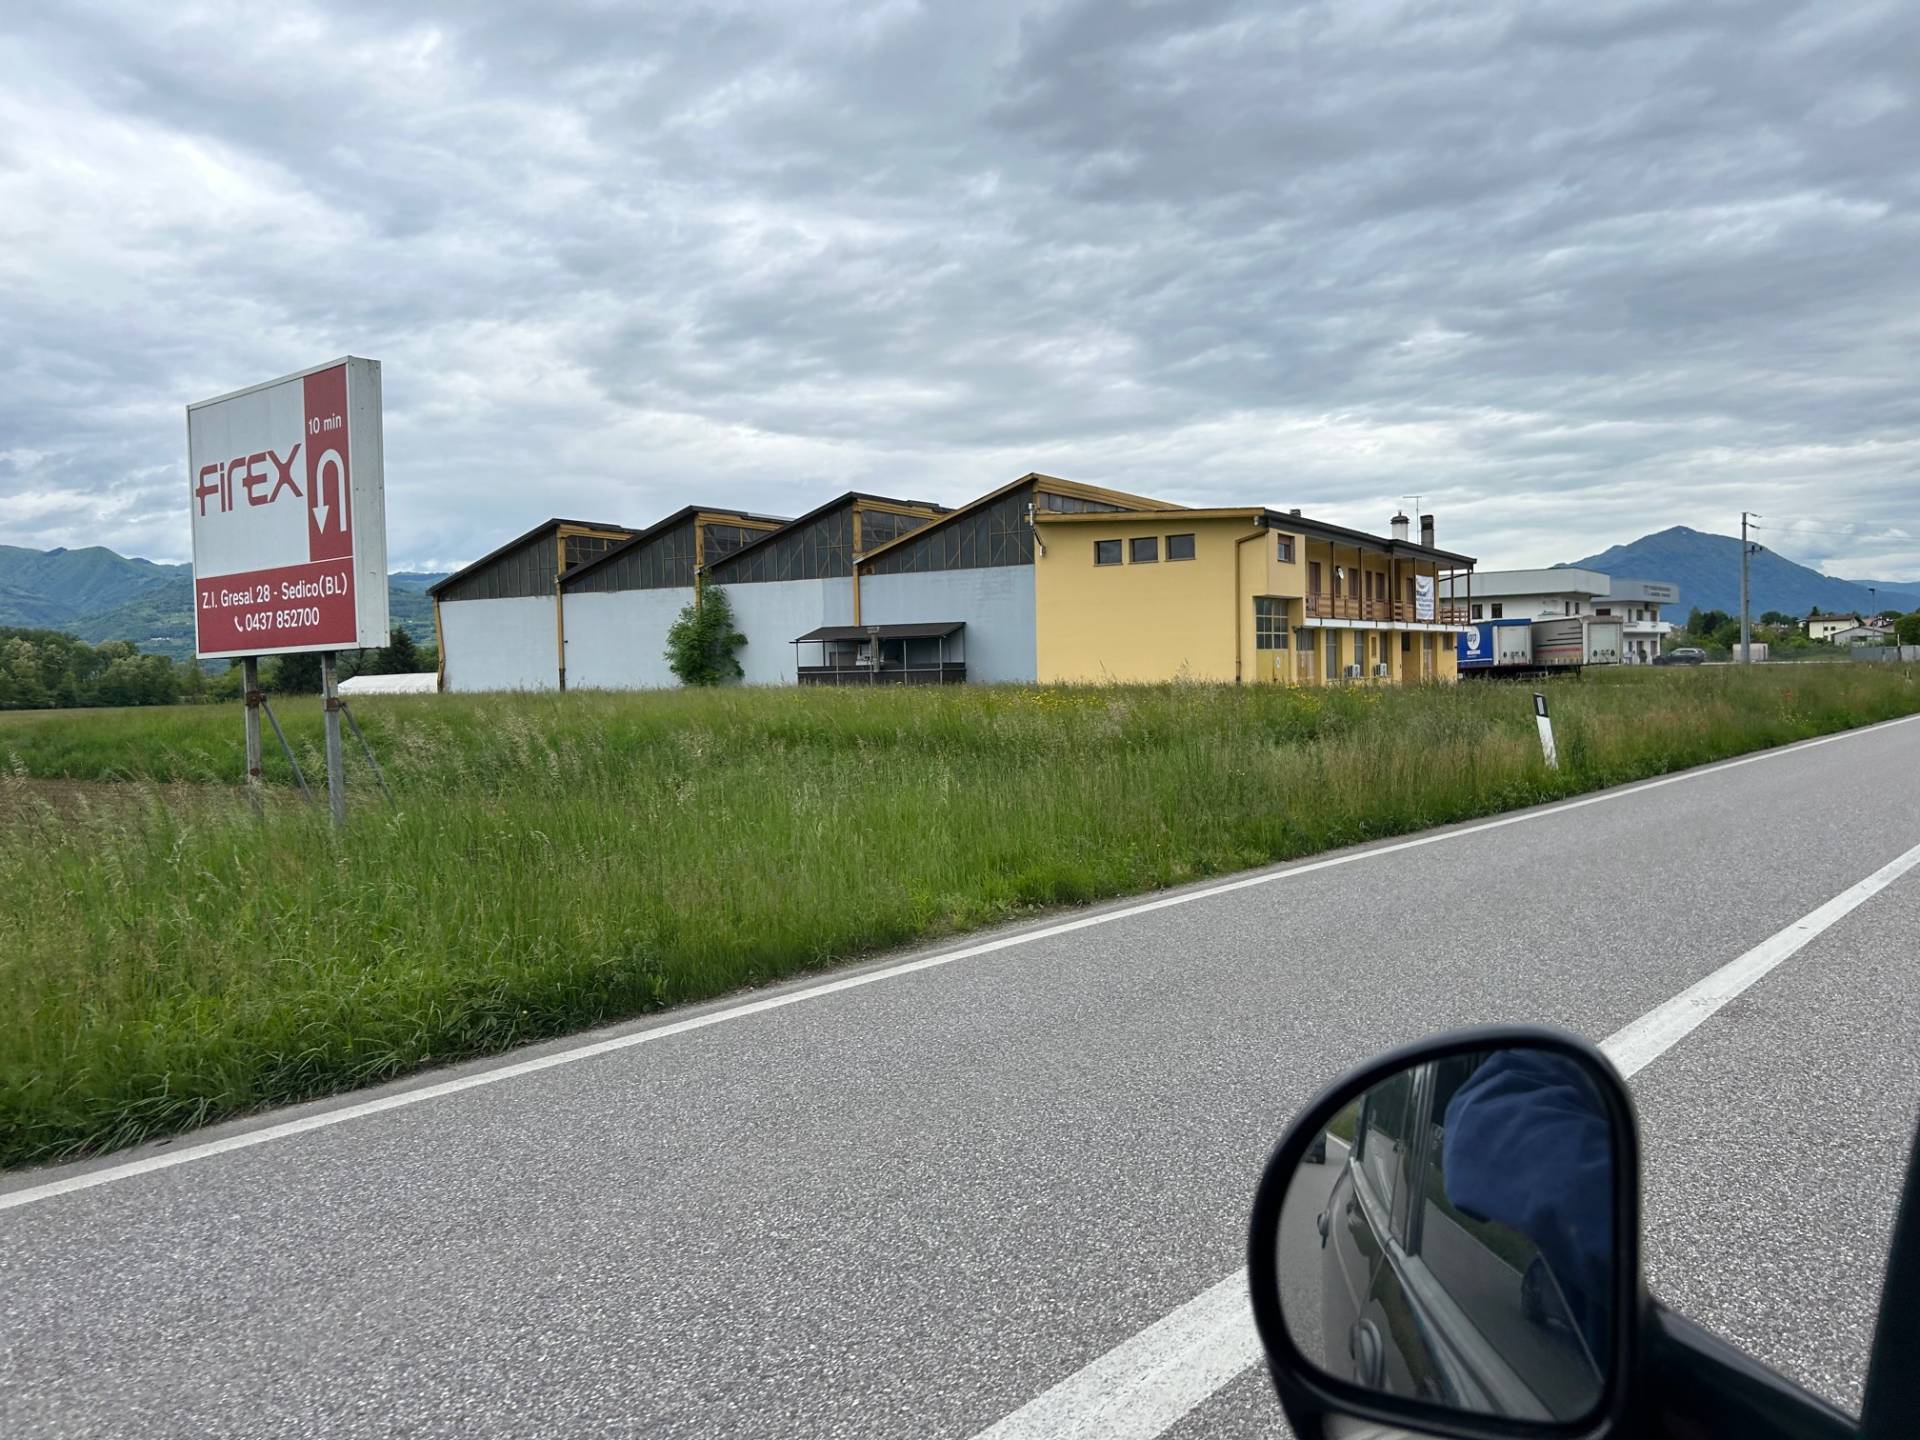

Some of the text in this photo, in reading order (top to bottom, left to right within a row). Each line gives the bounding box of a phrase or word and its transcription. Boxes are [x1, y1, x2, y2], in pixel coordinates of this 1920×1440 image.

[308, 412, 342, 435] 10 min
[202, 591, 218, 609] Z.I.
[220, 586, 254, 608] Gresal
[256, 584, 271, 603] 28
[245, 606, 320, 632] 0437 852700
